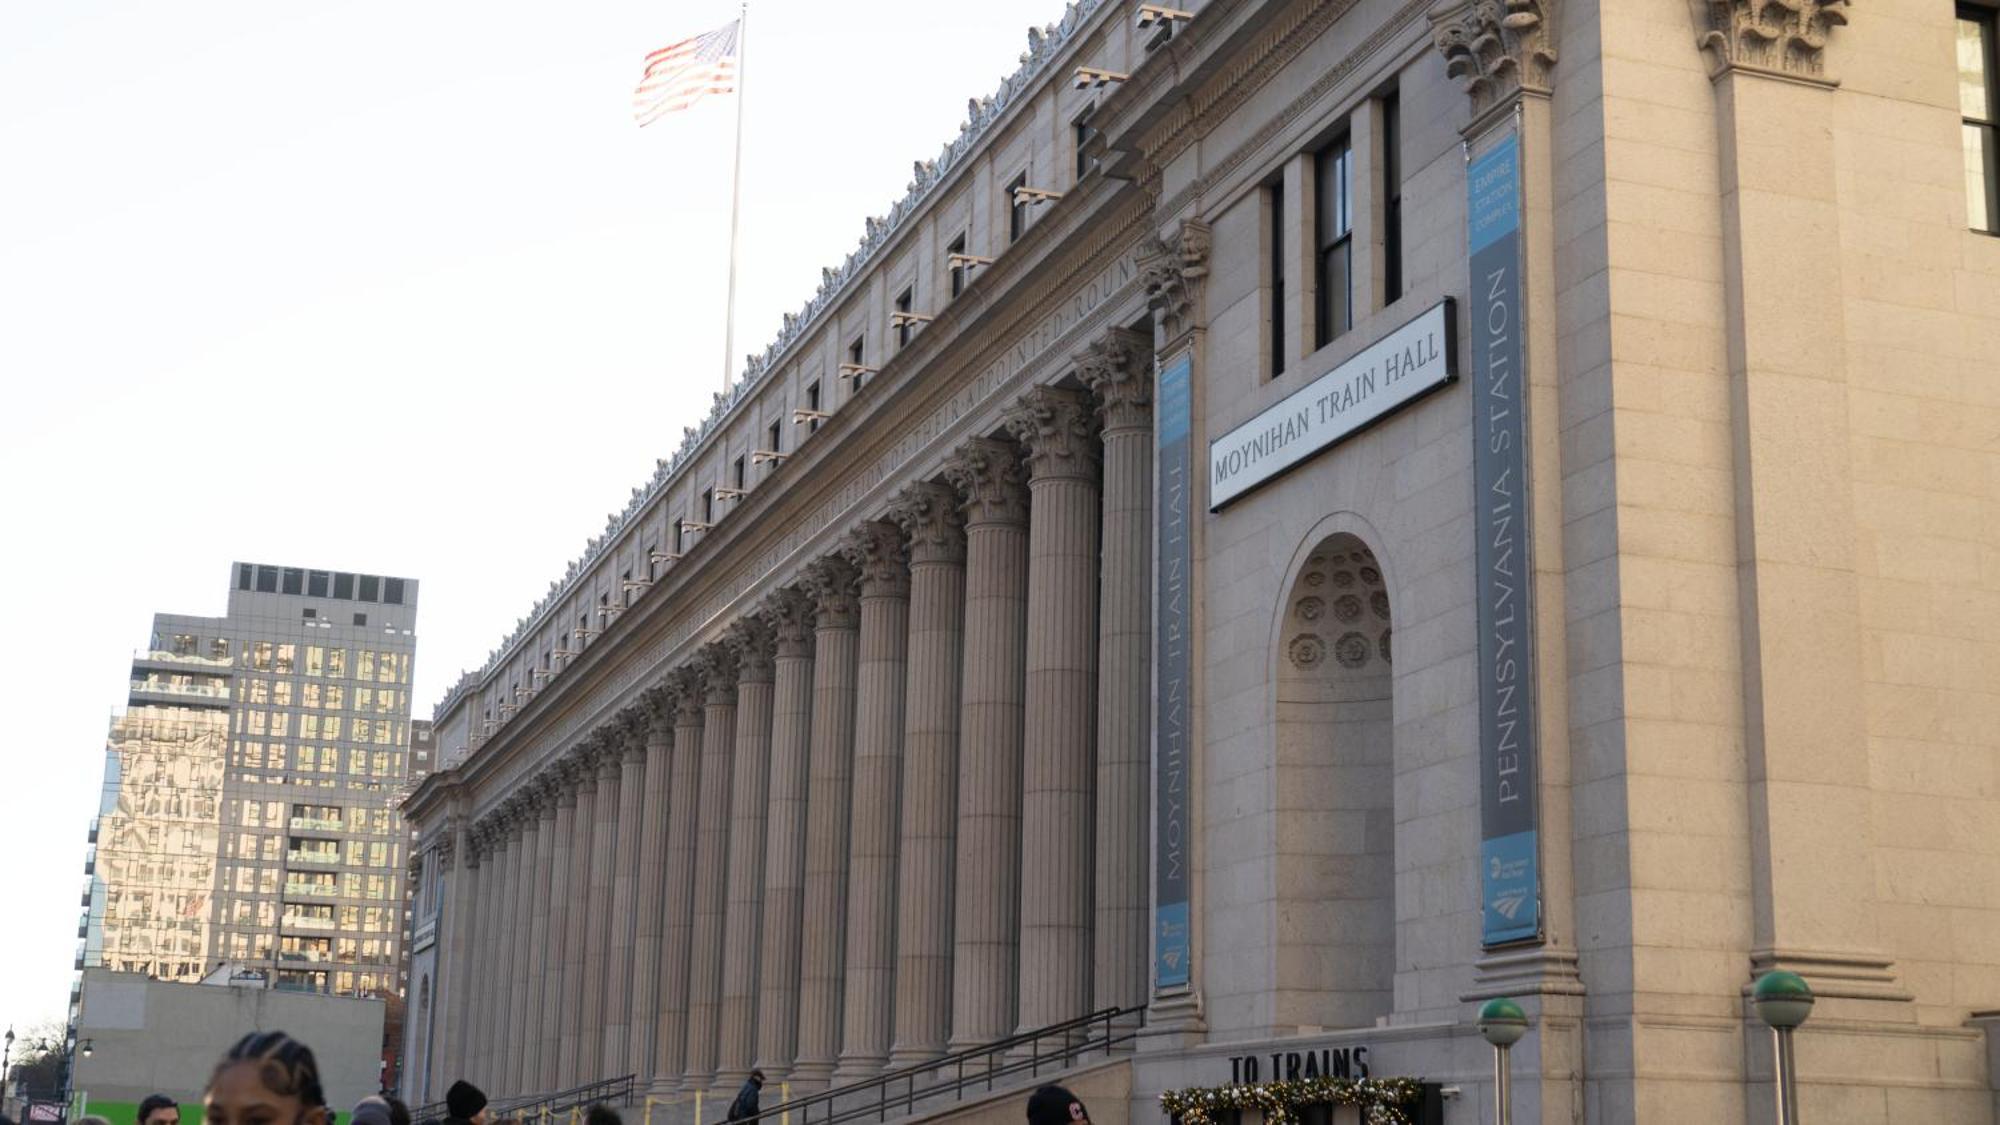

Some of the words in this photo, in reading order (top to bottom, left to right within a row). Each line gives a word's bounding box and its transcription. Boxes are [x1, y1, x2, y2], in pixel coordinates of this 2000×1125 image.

[1474, 160, 1511, 194] EMPIRE
[1475, 180, 1512, 210] STATION
[966, 313, 1063, 409] APPOINTED
[1214, 408, 1310, 485] MOYNIHAN
[1316, 367, 1376, 425] TRAIN
[1385, 332, 1439, 386] HALL
[1487, 266, 1510, 454] STATION
[1169, 456, 1182, 544] HALL
[1168, 557, 1182, 667] TRAIN
[1492, 467, 1519, 803] PENNSYLVANIA
[1167, 678, 1182, 879] MOYNIHAN
[1229, 1055, 1258, 1087] TO
[1270, 1046, 1369, 1082] TRAINS
